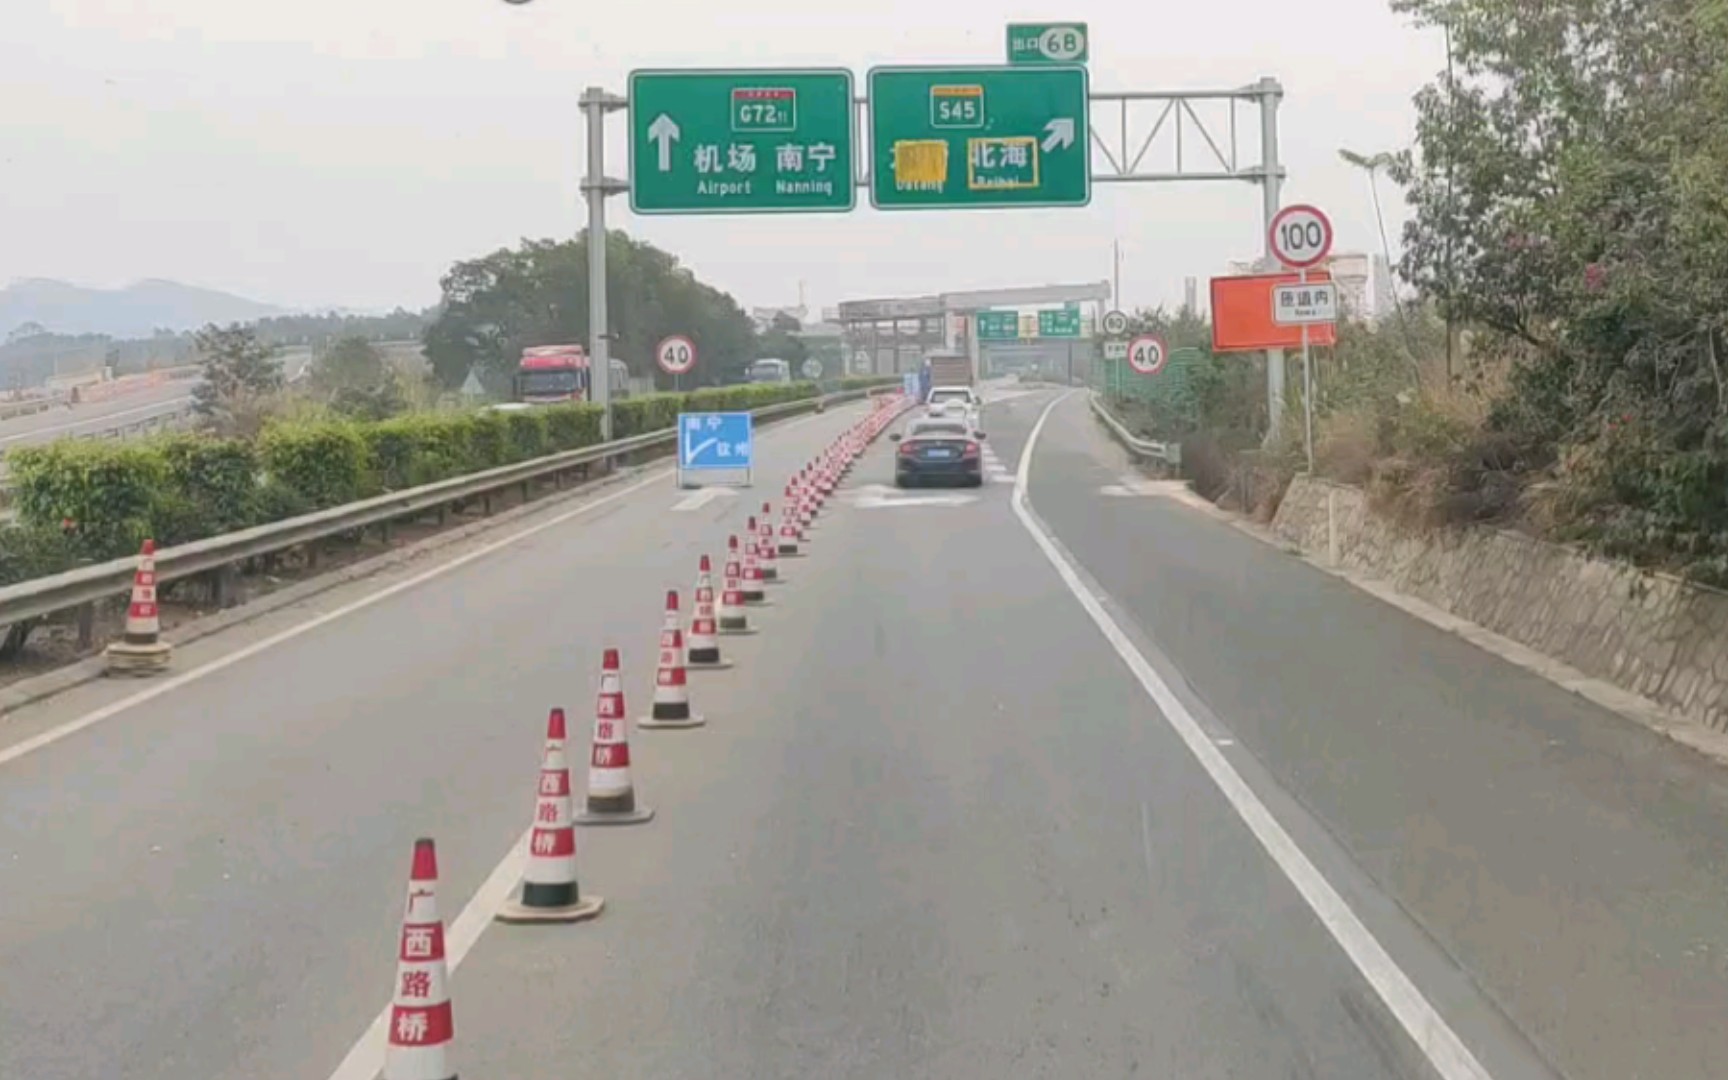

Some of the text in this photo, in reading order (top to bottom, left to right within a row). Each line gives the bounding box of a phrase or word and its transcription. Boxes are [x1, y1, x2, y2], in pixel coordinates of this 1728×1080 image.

[1014, 38, 1039, 50] 出口
[939, 102, 975, 119] S45
[694, 142, 836, 172] 机场 南宁
[974, 143, 1027, 167] 北海
[697, 180, 832, 196] Airport Nanning
[1281, 221, 1322, 251] 100
[664, 346, 688, 364] 40
[1134, 346, 1159, 365] 40
[397, 889, 435, 1042] 广西路桥
